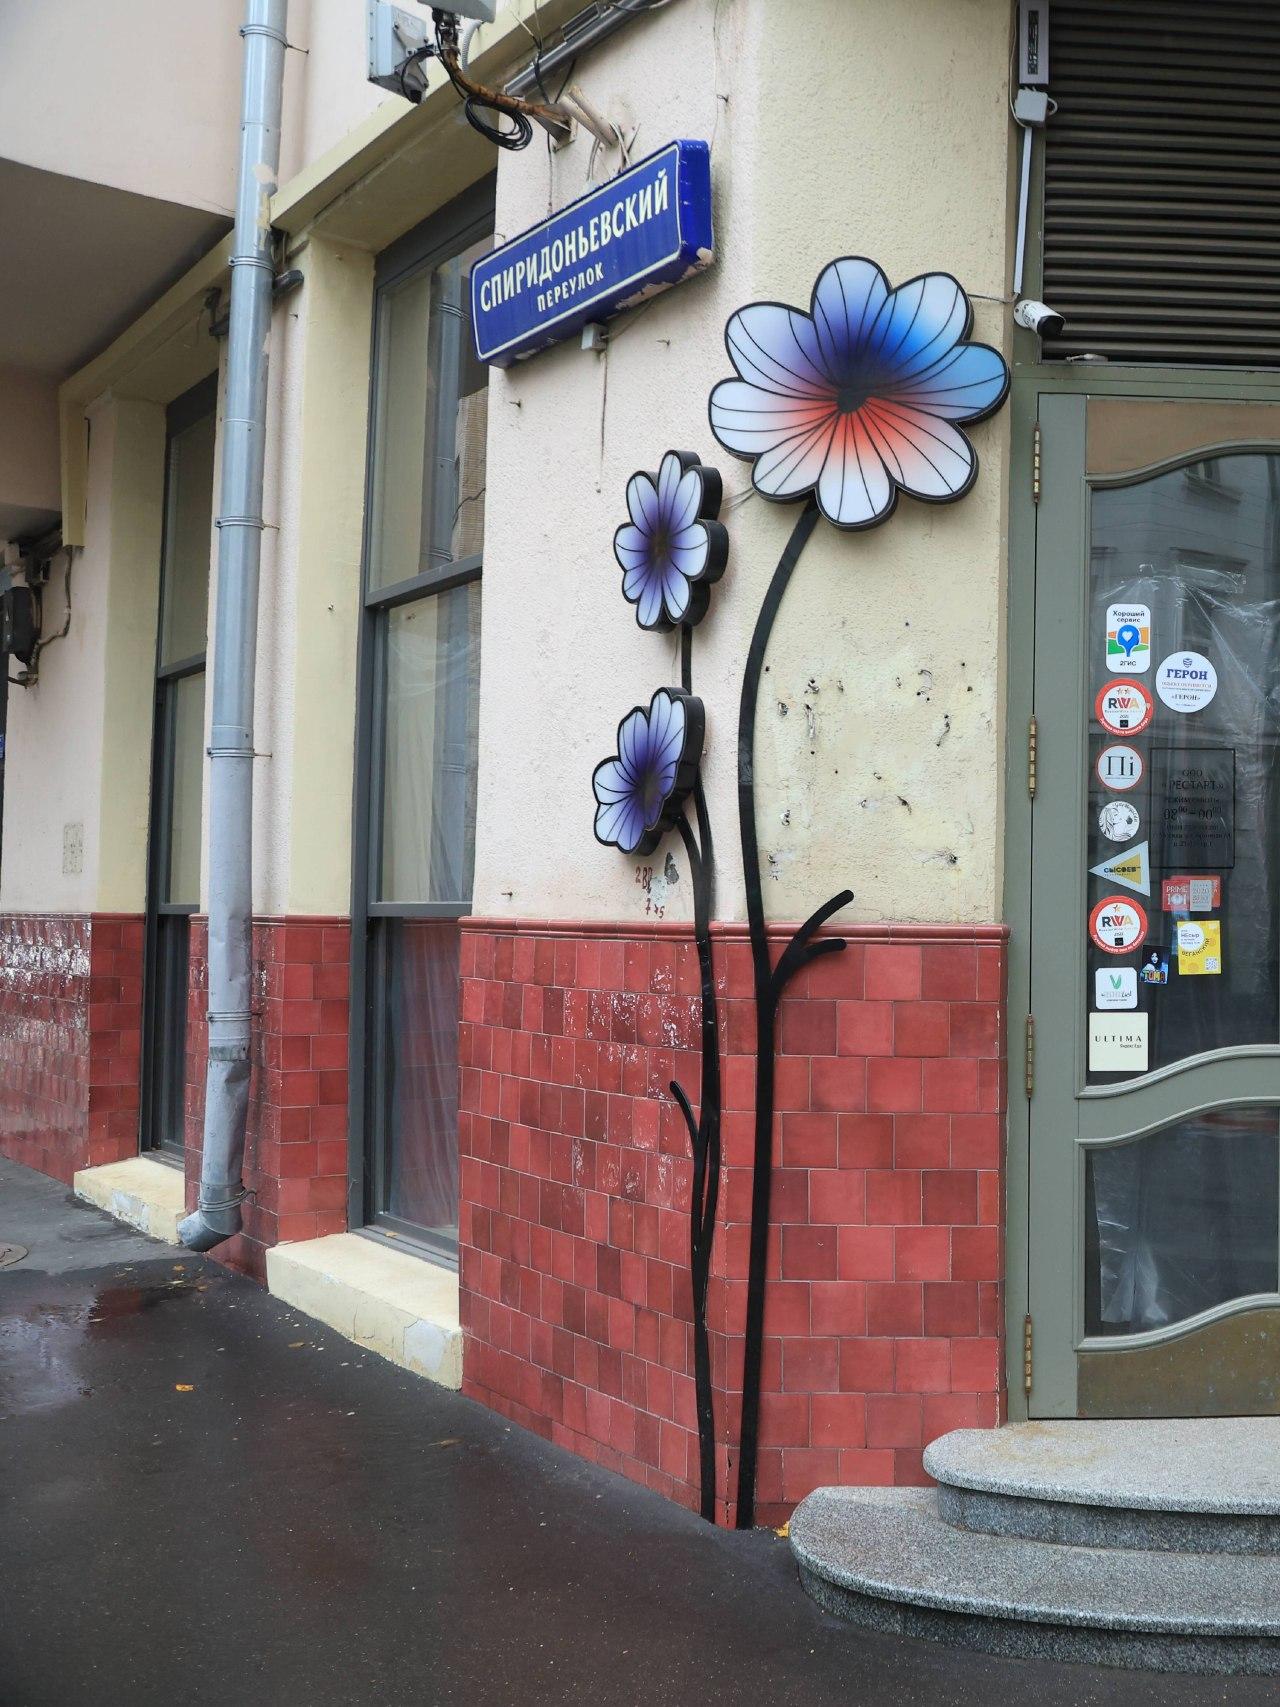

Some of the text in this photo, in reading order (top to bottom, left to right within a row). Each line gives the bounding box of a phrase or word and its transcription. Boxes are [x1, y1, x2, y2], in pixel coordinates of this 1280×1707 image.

[480, 168, 668, 312] СПИРИДОНЬЕВСКИЙ
[537, 262, 604, 312] ПЕРЕУЛОК
[1166, 669, 1208, 680] ГЕРОН
[1108, 697, 1140, 709] RWA
[1166, 885, 1188, 893] PRIME
[1102, 915, 1133, 928] RWA
